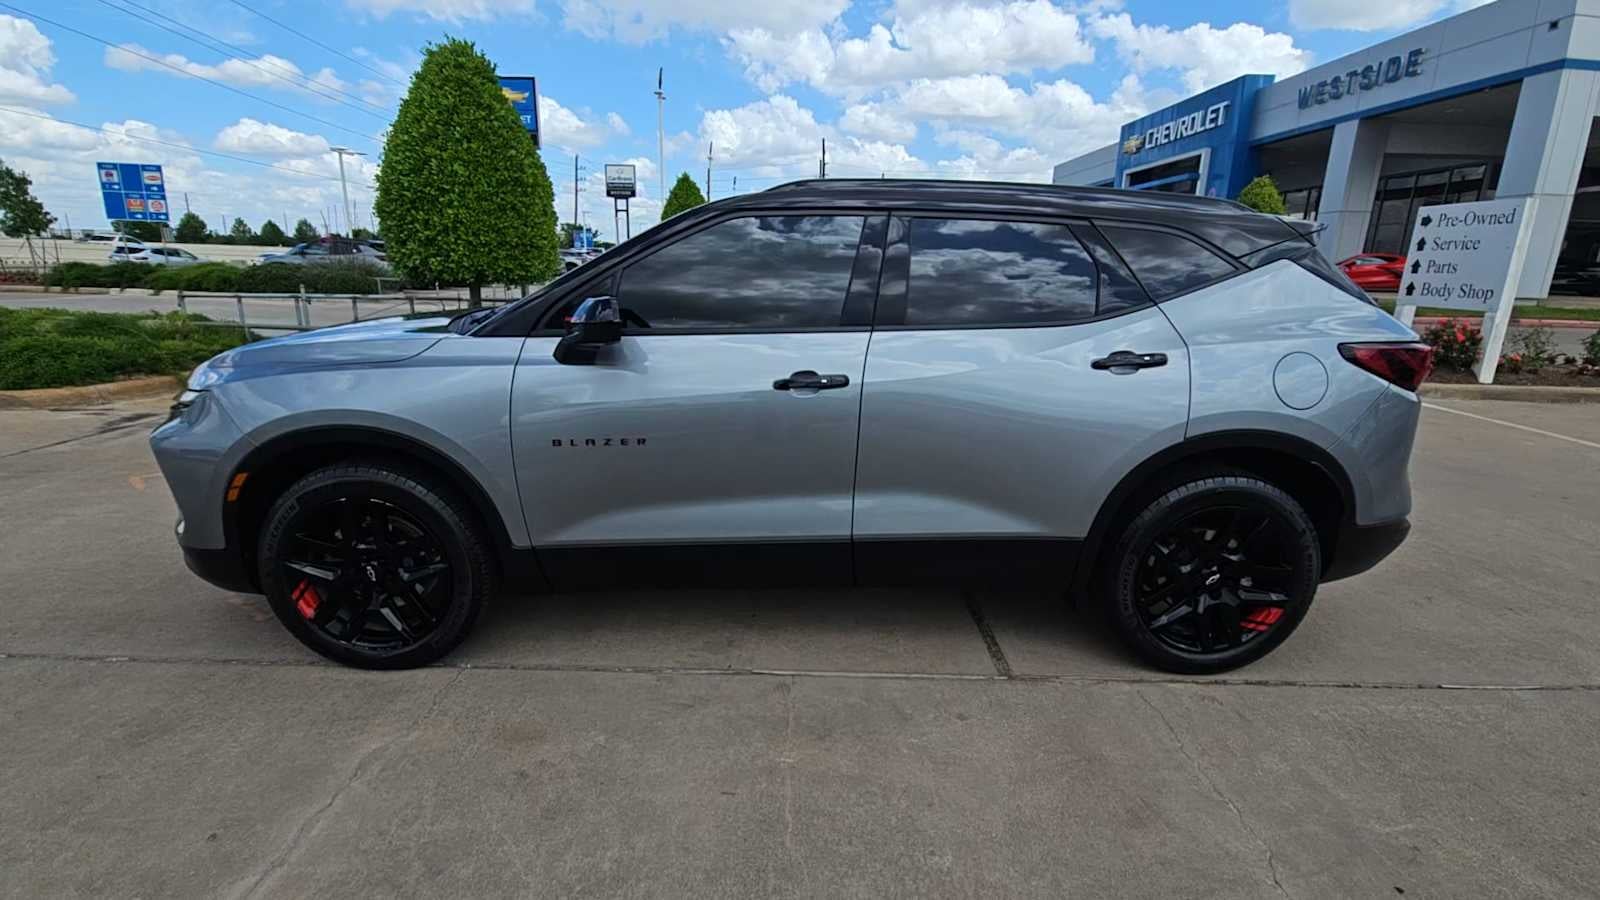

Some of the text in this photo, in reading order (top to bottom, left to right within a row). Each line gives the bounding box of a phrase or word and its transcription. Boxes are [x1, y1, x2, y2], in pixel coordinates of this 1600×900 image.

[1298, 48, 1425, 110] WESTSIDE
[1144, 101, 1231, 149] CHEVROLET
[1437, 208, 1516, 227] Pre-Owned
[1431, 235, 1481, 251] Service
[1425, 259, 1458, 274] Parts
[1420, 282, 1494, 304] Body Shop
[552, 438, 647, 447] BLAZER
